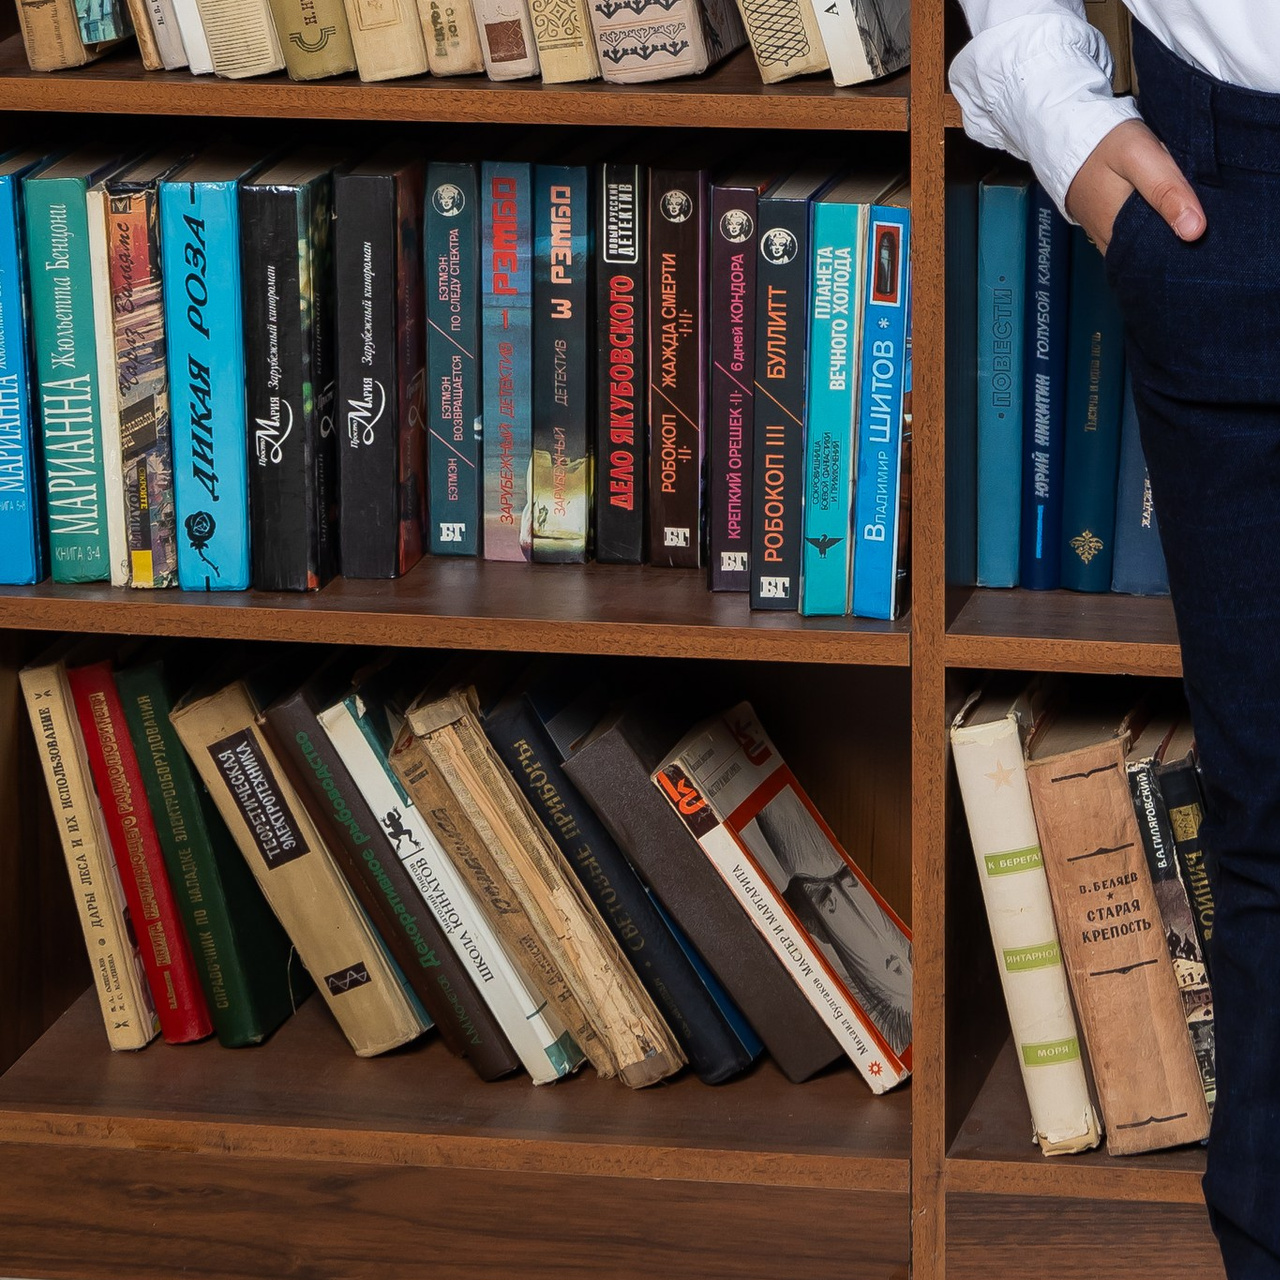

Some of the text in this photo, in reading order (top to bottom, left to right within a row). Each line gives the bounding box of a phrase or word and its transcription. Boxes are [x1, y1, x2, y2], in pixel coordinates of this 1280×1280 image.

[491, 177, 518, 295] РЭМБО
[550, 185, 573, 284] РЭМБО
[608, 183, 619, 255] НОВЫЙ РУССКИЙ
[618, 183, 635, 257] ДЕТЕКТИВ
[266, 265, 282, 390] Зарубежный кинороман
[361, 240, 376, 367] Зарубежный кинороман
[448, 229, 463, 331] ПО СЛЕДУ СПЕКТРА
[661, 253, 677, 389] ЖАЖДА СМЕРТИ
[731, 253, 747, 372] 6 дней КОНДОРА
[767, 285, 789, 380] БУЛЛИТТ
[815, 247, 833, 320] ПЛАНЕТА
[830, 247, 851, 392] ВЕЧНОГО ХОЛОДА
[1035, 208, 1053, 447] НИКИТИН ГОЛУБОЙ КАРАНТИН
[42, 204, 100, 536] МАРИАННА Жюльетта Бенцони
[183, 213, 219, 502] ДИКАЯ РОЗА
[441, 376, 452, 419] БЭТМЭН
[450, 355, 465, 441] ВОЗВРАЩАЕТСЯ
[608, 275, 636, 511] ДЕЛО ЯКУБОВСКОГО
[868, 340, 895, 444] ШИТОВ
[992, 288, 1013, 407] ПОВЕСТИ
[498, 342, 515, 526] ЗАРУБЕЖНЫЙ ДЕТЕКТИВ
[552, 339, 568, 517] ЗАРУБЕЖНЫЙ ДЕТЕКТИВ
[661, 414, 677, 493] РОБОКОП
[1084, 395, 1099, 433] Тысяча
[447, 458, 459, 500] БЭТМЭН
[727, 407, 743, 540] КРЕПКИЙ ОРЕШЕК
[765, 453, 785, 562] РОБОКОП
[56, 547, 84, 561] КНИГА
[38, 706, 104, 928] ДАРЫ ЛЕСА ИХ ИСПОЛЬЗОВАНИЕ
[89, 691, 160, 919] НАЧИНАЮЩЕГО РАДИОЛЮБИТЕЛЯ
[136, 694, 231, 1010] СПРАВОЧНИК ПО НАЛАДКЕ ЭЛЕКТРООБОРУДОВАНИЯ
[218, 749, 282, 860] ТЕОРЕТИЧЕСКАЯ
[236, 740, 297, 851] ЭЛЕКТРОТЕХНИКА
[295, 731, 441, 969] Декоративное рыбоводство
[512, 737, 647, 952] СВЕТОВЫЕ ПРИБОРЫ
[409, 862, 456, 935] Анатолий Онегов
[415, 856, 495, 983] ШКОЛА ЮННАТОВ
[1082, 918, 1153, 945] КРЕПОСТЬ
[1086, 899, 1142, 924] СТАРАЯ
[1184, 849, 1216, 942] ВОЙНИЧ
[731, 863, 870, 1057] Михаил Булгаков МАСТЕР МАРГАРИТА
[1036, 1044, 1070, 1059] МОРЯ
